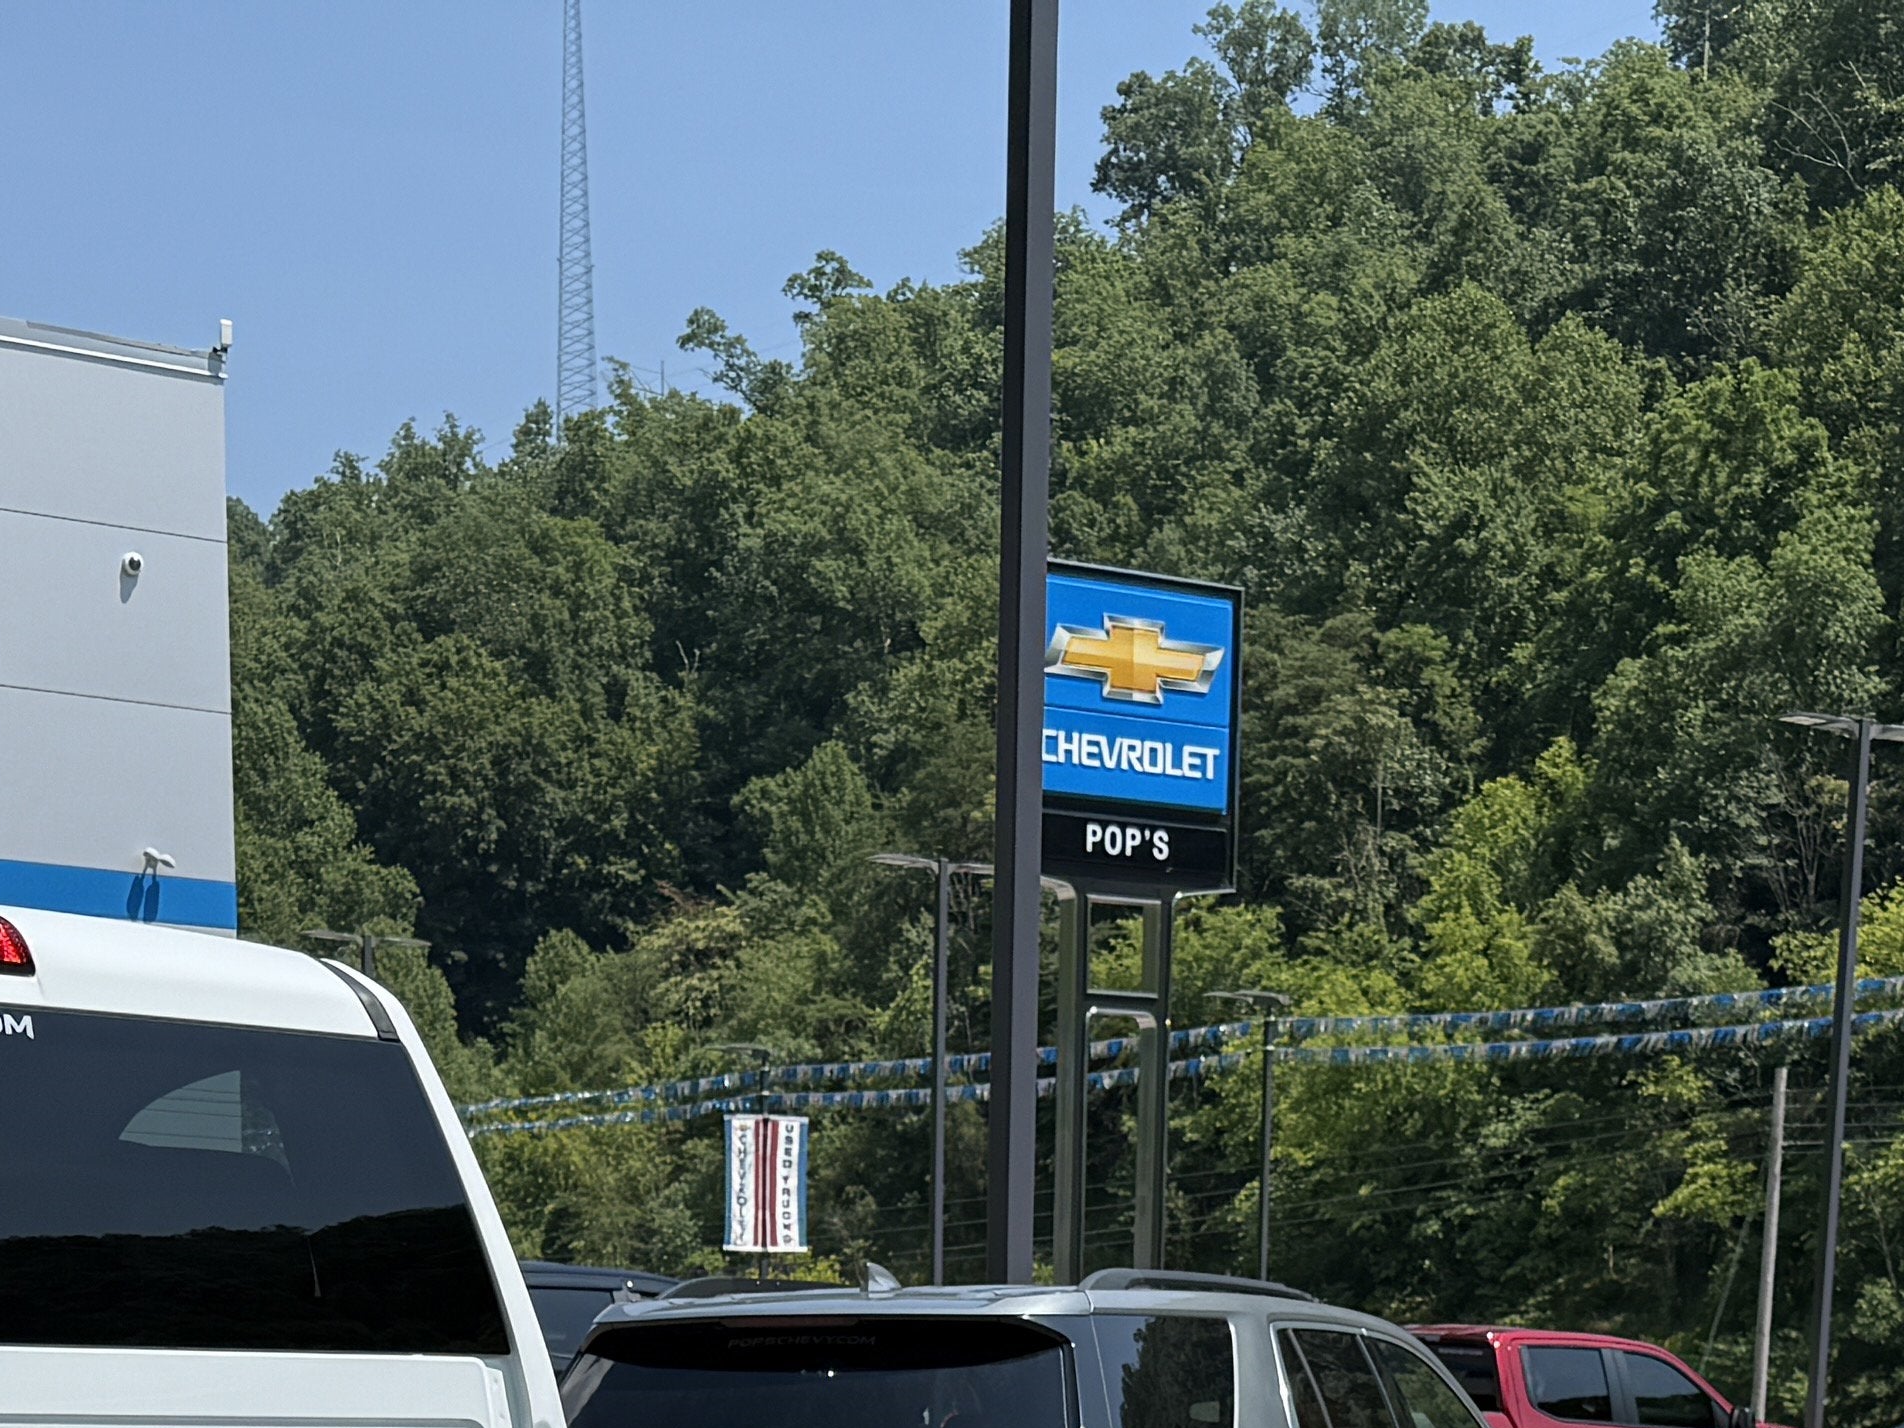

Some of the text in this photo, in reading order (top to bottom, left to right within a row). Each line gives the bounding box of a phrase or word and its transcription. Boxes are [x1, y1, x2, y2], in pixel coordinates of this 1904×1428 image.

[1042, 729, 1220, 780] CHEVROLET
[1086, 822, 1170, 861] POP'S
[782, 1124, 795, 1169] USED
